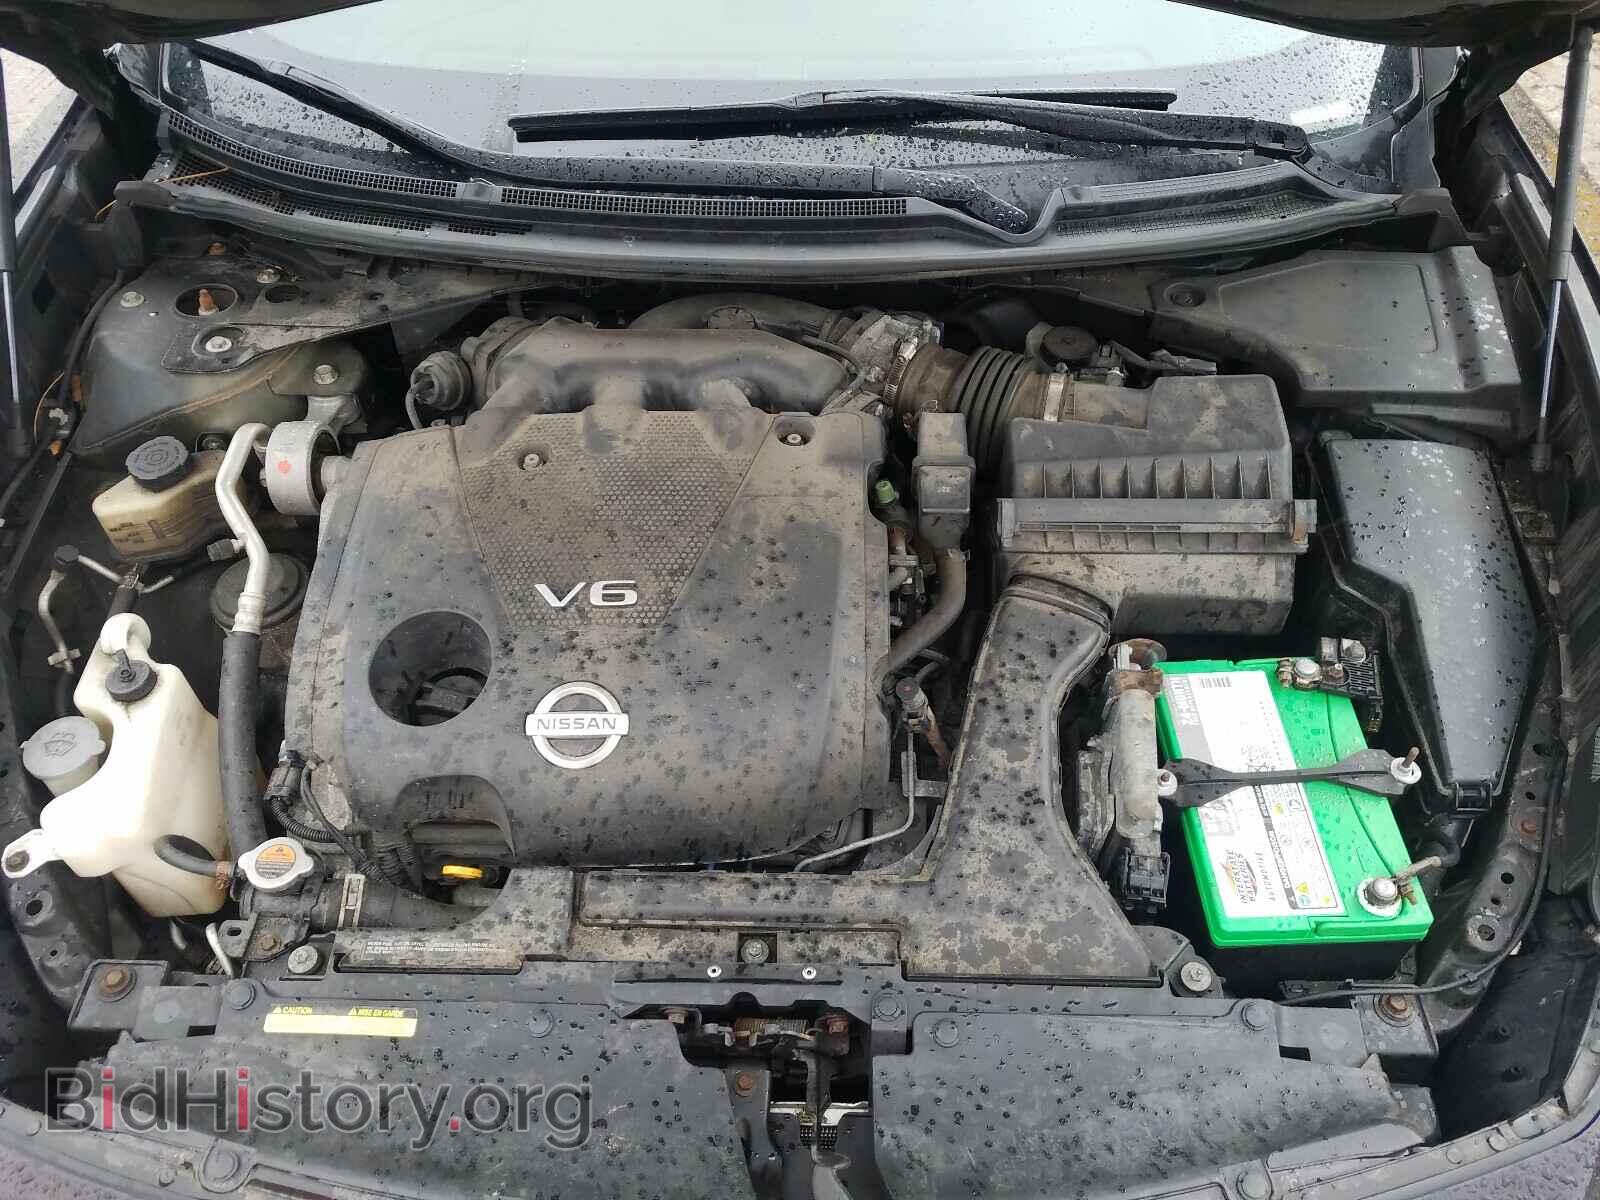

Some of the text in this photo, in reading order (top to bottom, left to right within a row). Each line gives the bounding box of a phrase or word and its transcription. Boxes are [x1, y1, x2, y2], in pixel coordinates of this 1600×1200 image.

[534, 580, 638, 607] V6
[537, 717, 616, 730] NISSAN
[1226, 849, 1248, 904] INTERSTATE
[1236, 852, 1257, 903] BATTERIES
[281, 1006, 313, 1014] CAUTION
